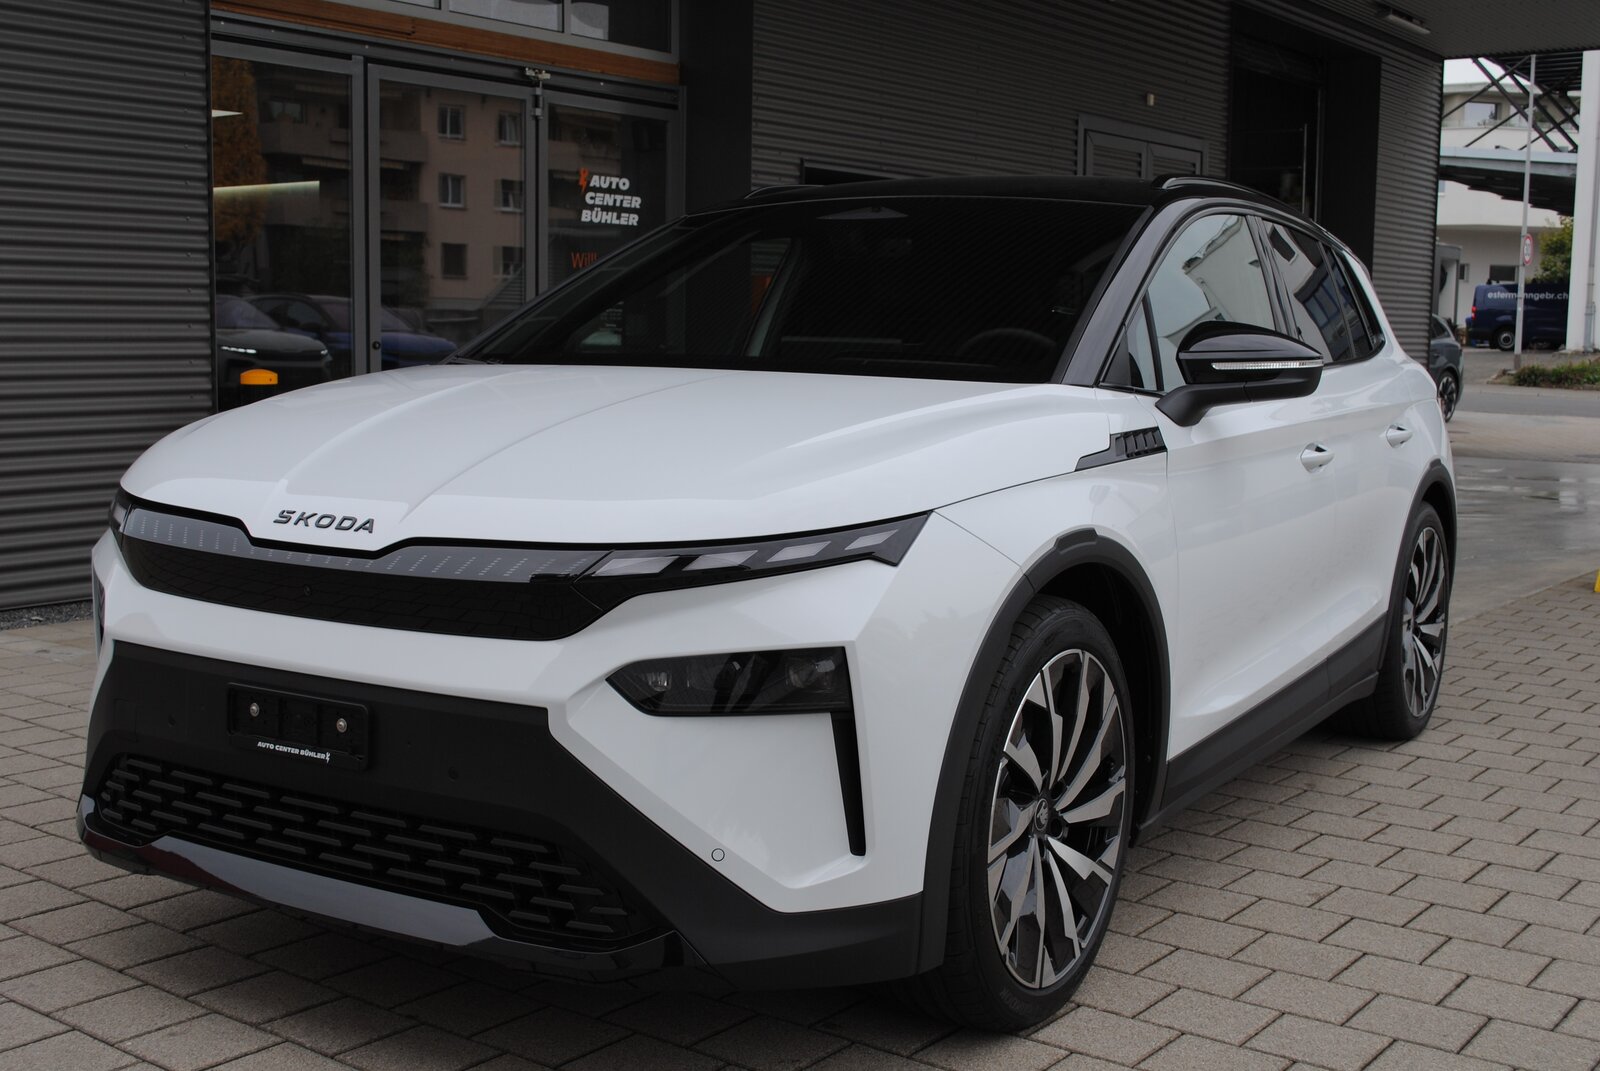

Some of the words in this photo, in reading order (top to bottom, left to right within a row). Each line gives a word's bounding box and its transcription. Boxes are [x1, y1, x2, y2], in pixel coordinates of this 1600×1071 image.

[589, 174, 630, 191] AUTO
[585, 191, 642, 209] CENTER
[581, 207, 639, 226] BÜHLER
[1487, 291, 1568, 301] estermnngebr.ch
[257, 741, 275, 750] AUTO
[275, 744, 299, 755] CENTER
[300, 749, 326, 760] BÜHLER
